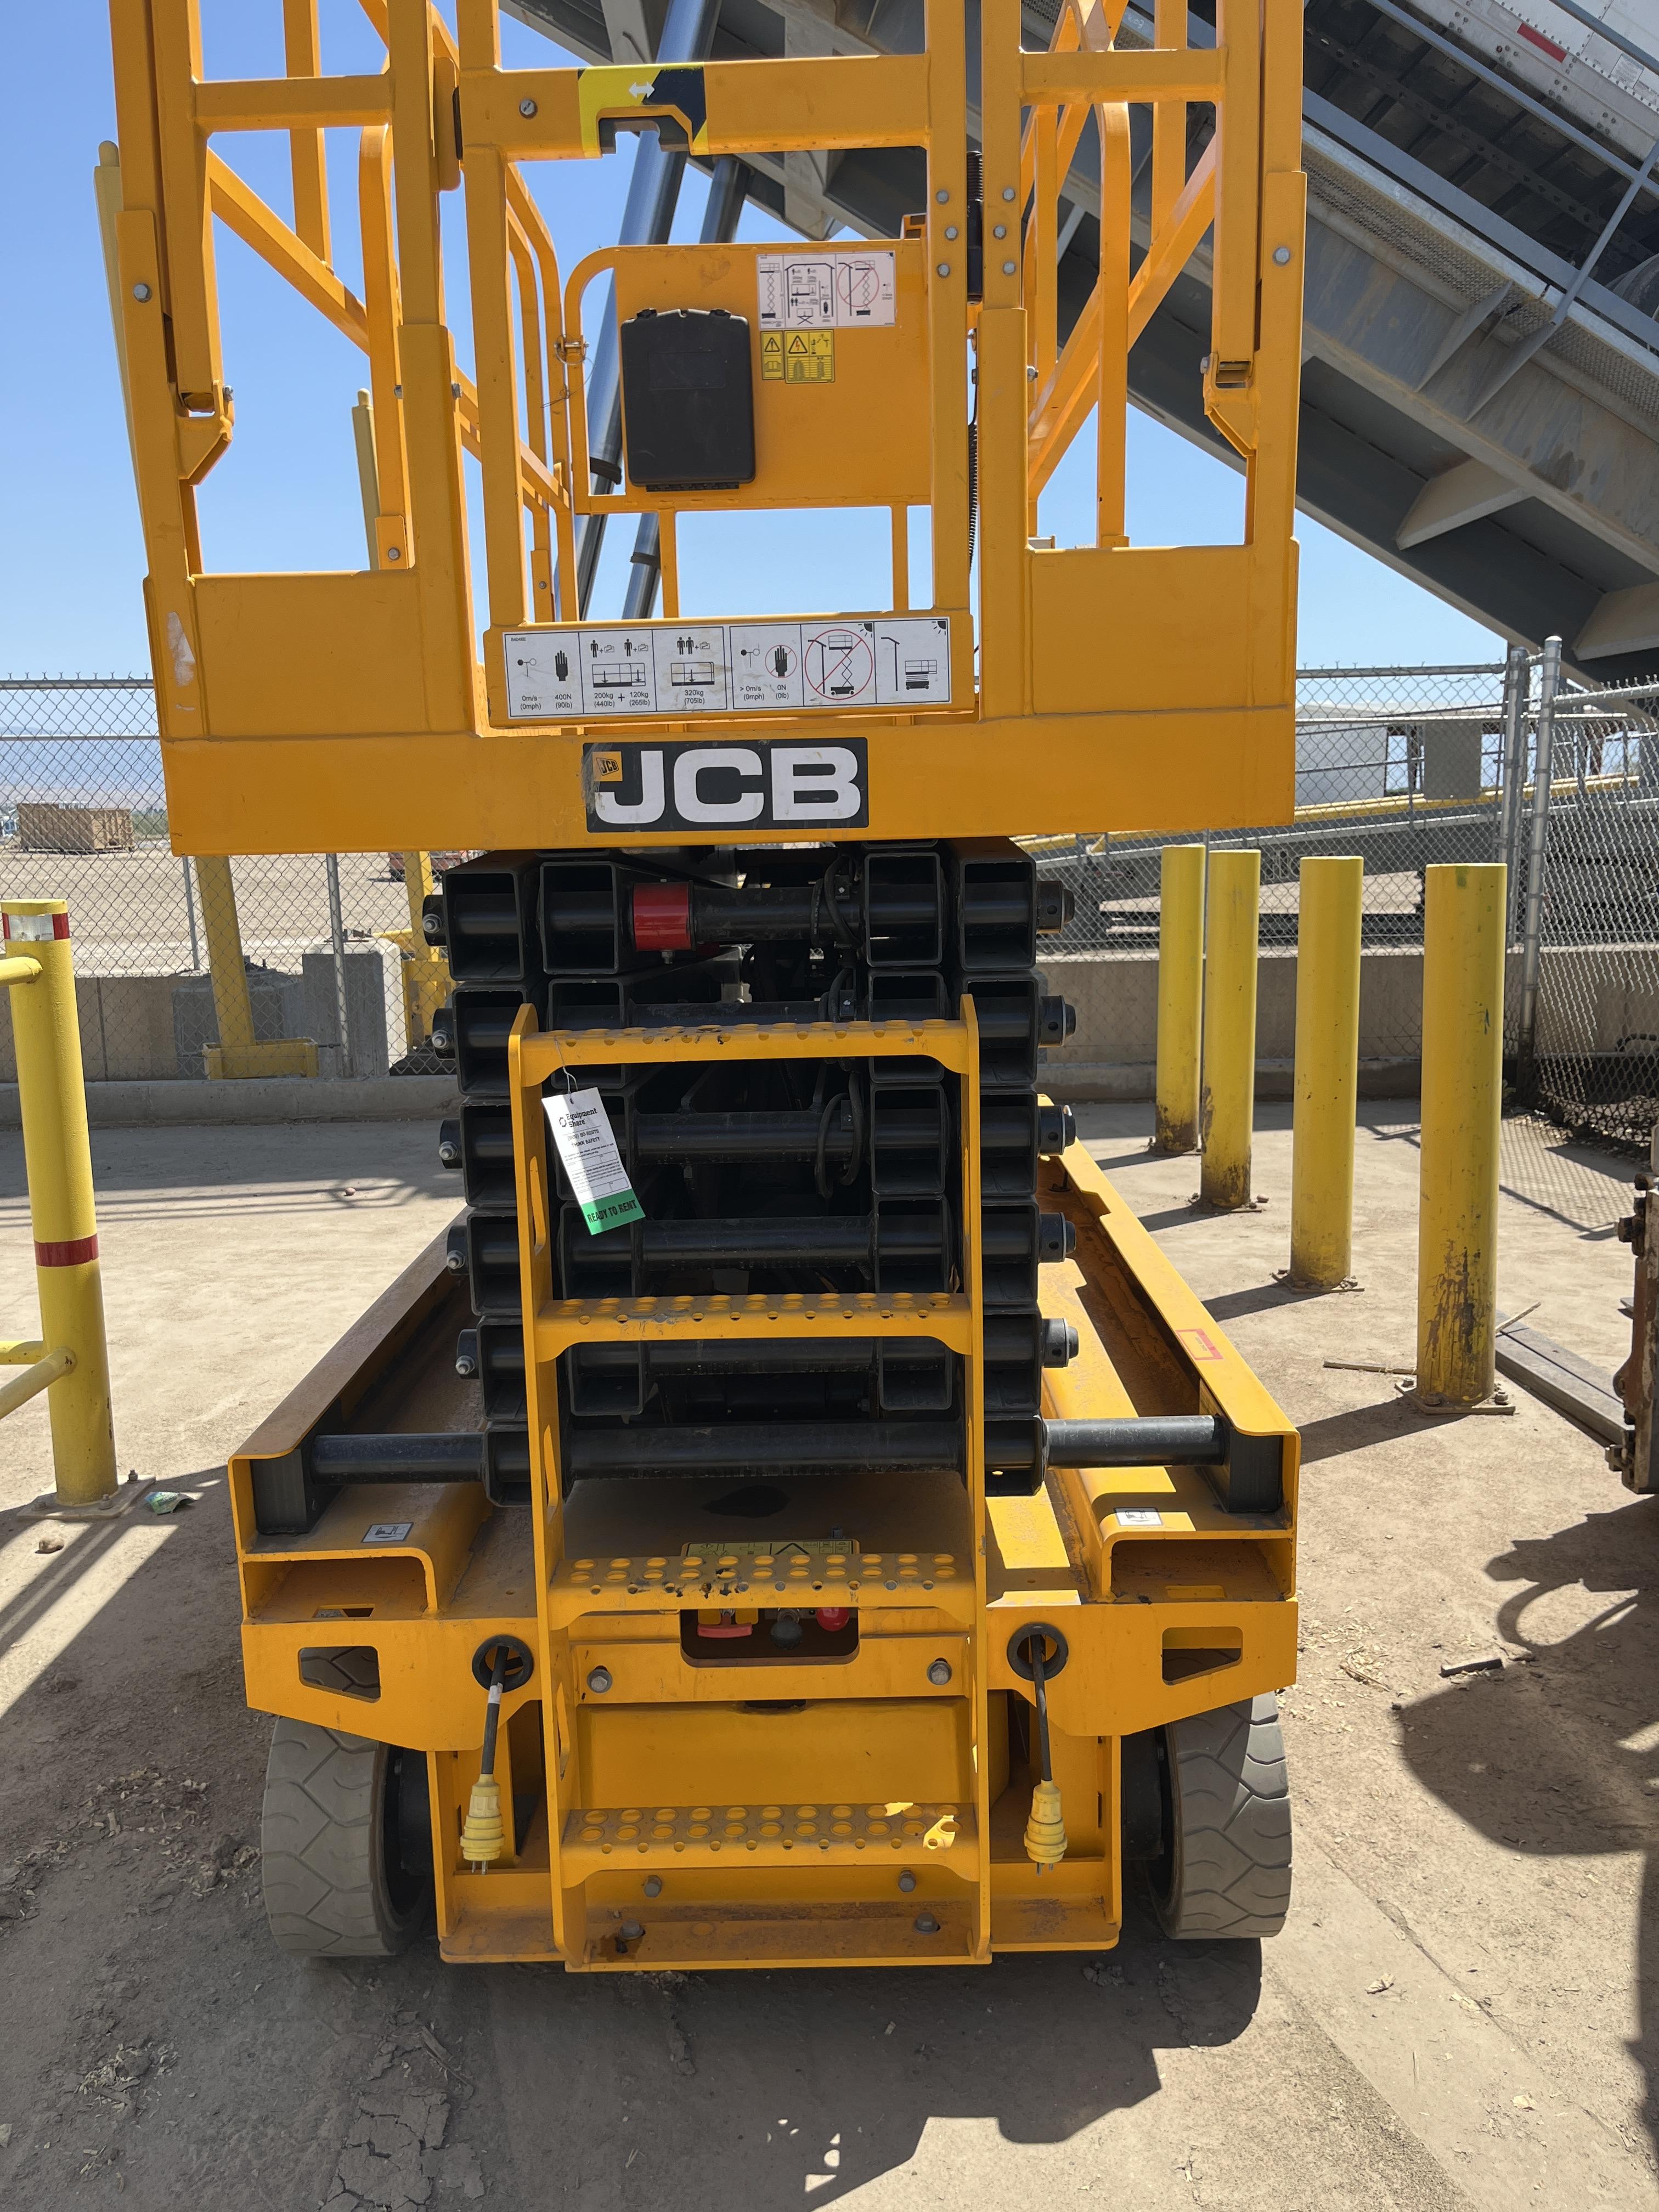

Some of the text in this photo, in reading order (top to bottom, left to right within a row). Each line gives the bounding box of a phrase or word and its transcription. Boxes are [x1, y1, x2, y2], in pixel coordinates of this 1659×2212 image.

[743, 693, 765, 701] (0mph)
[594, 700, 615, 708] (440lb)
[629, 699, 650, 707] (265lb)
[684, 697, 705, 706] (705lb)
[600, 759, 618, 774] JCB
[595, 747, 861, 824] JCB
[566, 1108, 598, 1120] Equipment
[568, 1119, 586, 1127] Share
[585, 1136, 600, 1144] SAFETY
[587, 1199, 637, 1223] READY TO RENT
